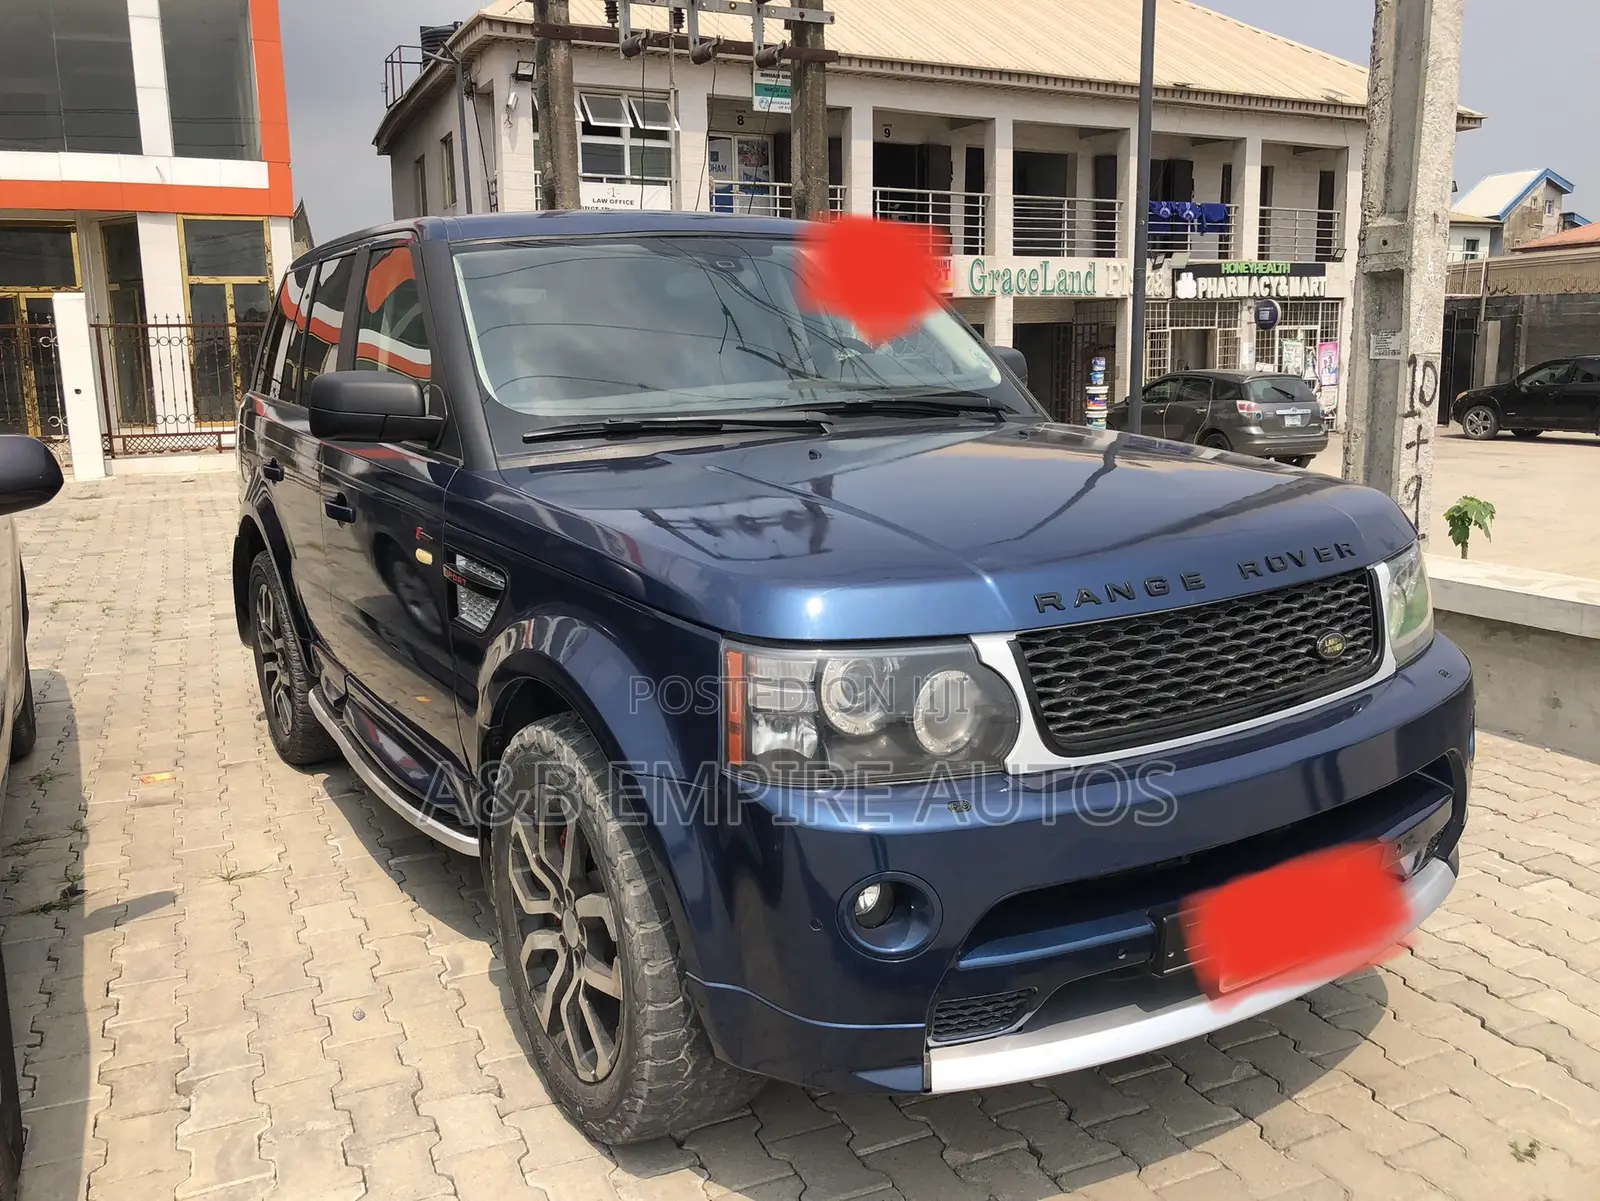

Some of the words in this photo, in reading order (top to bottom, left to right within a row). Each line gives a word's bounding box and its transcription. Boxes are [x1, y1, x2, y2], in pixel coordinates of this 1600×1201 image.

[736, 114, 744, 126] 8
[884, 127, 891, 138] 9
[969, 257, 1097, 296] GraceLand
[1220, 263, 1291, 274] HONEYHEALTH
[1196, 276, 1327, 299] PHARMACY&MART
[1401, 353, 1439, 418] 10
[444, 569, 467, 586] SPORT
[1033, 571, 1207, 614] RANGE
[1236, 541, 1357, 580] ROVER
